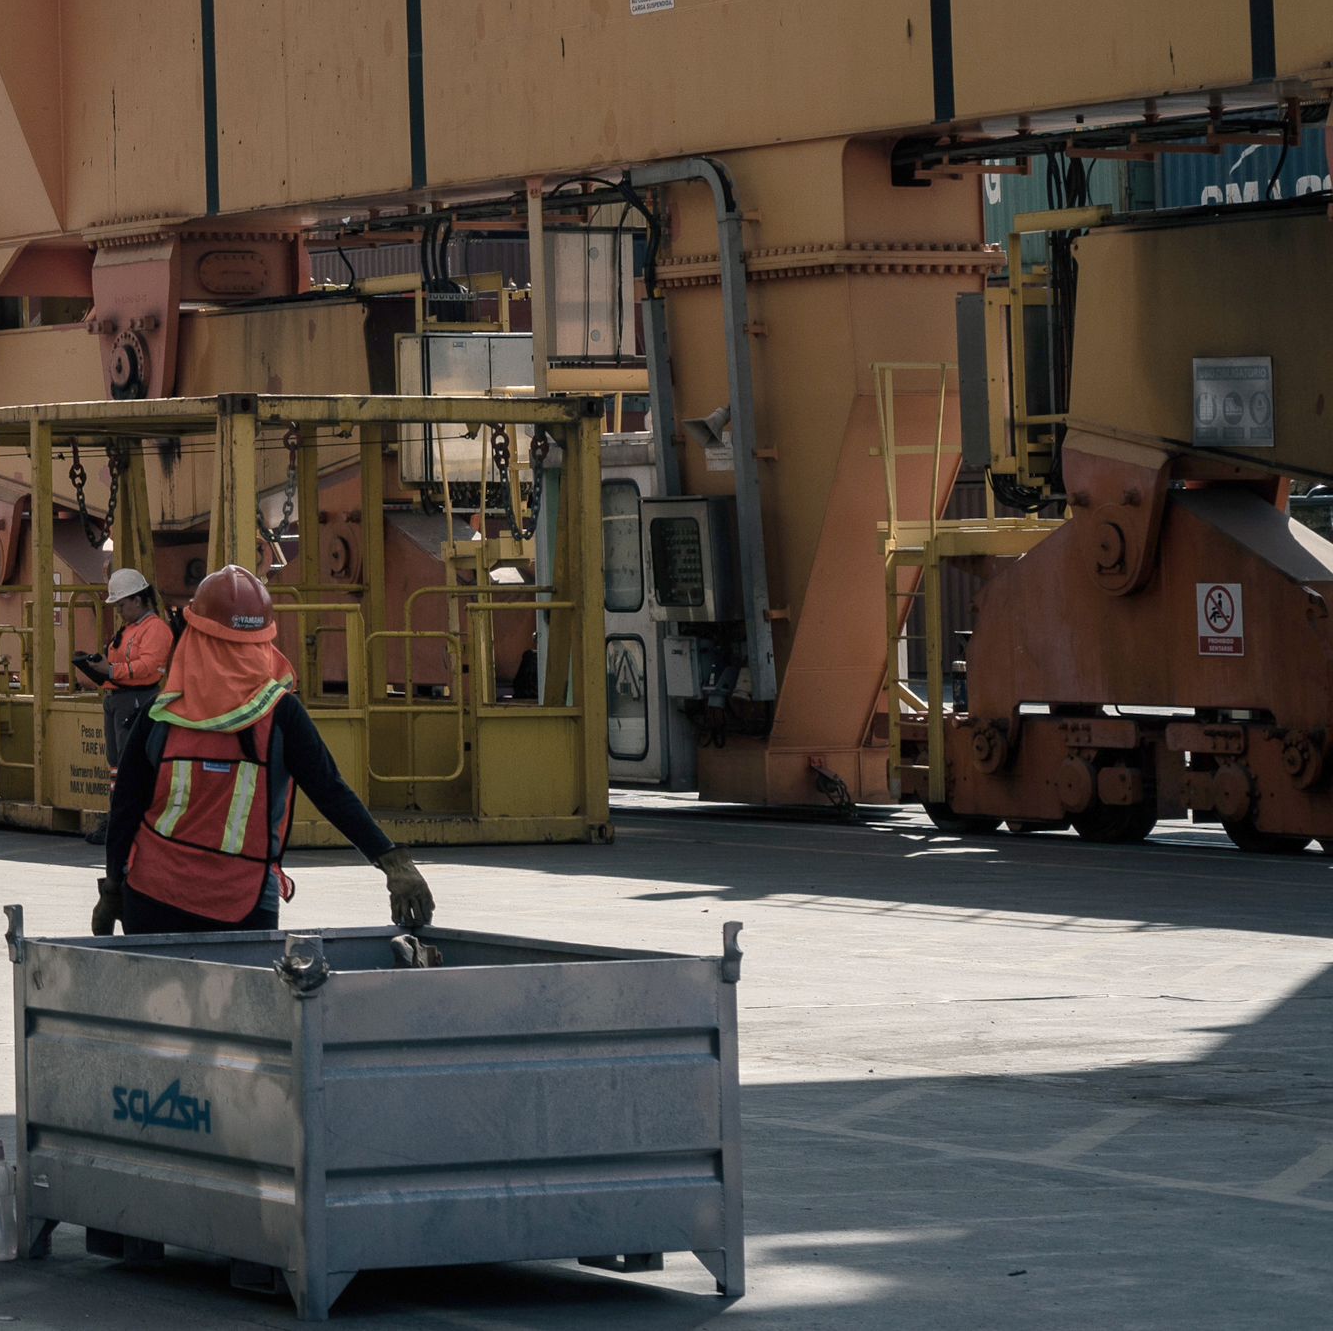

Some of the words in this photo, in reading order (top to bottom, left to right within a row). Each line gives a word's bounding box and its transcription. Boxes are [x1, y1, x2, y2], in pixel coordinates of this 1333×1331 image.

[82, 725, 94, 738] Peso
[96, 729, 102, 738] en
[82, 742, 98, 755] TARE
[70, 781, 84, 794] MAX
